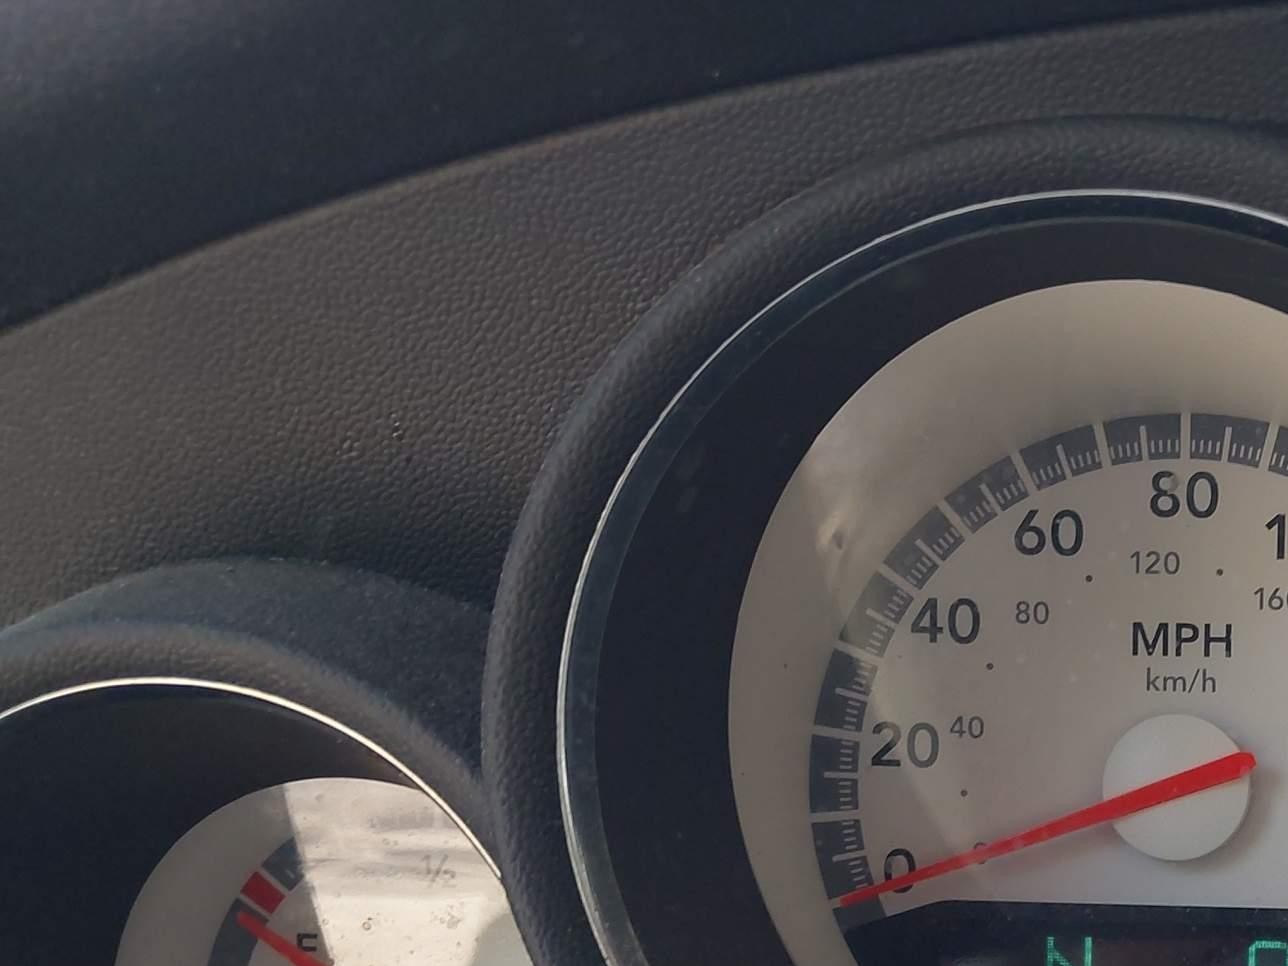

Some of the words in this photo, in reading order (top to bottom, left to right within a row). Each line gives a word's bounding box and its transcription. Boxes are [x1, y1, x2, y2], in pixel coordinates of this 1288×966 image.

[1149, 470, 1220, 519] 80
[1014, 508, 1084, 557] 60
[1129, 550, 1181, 576] 120
[910, 596, 981, 645] 40
[1015, 600, 1050, 625] 80
[1131, 621, 1234, 658] MPH
[1145, 666, 1217, 694] km/h
[871, 720, 940, 769] 20
[949, 715, 985, 741] 40
[883, 847, 917, 894] 0
